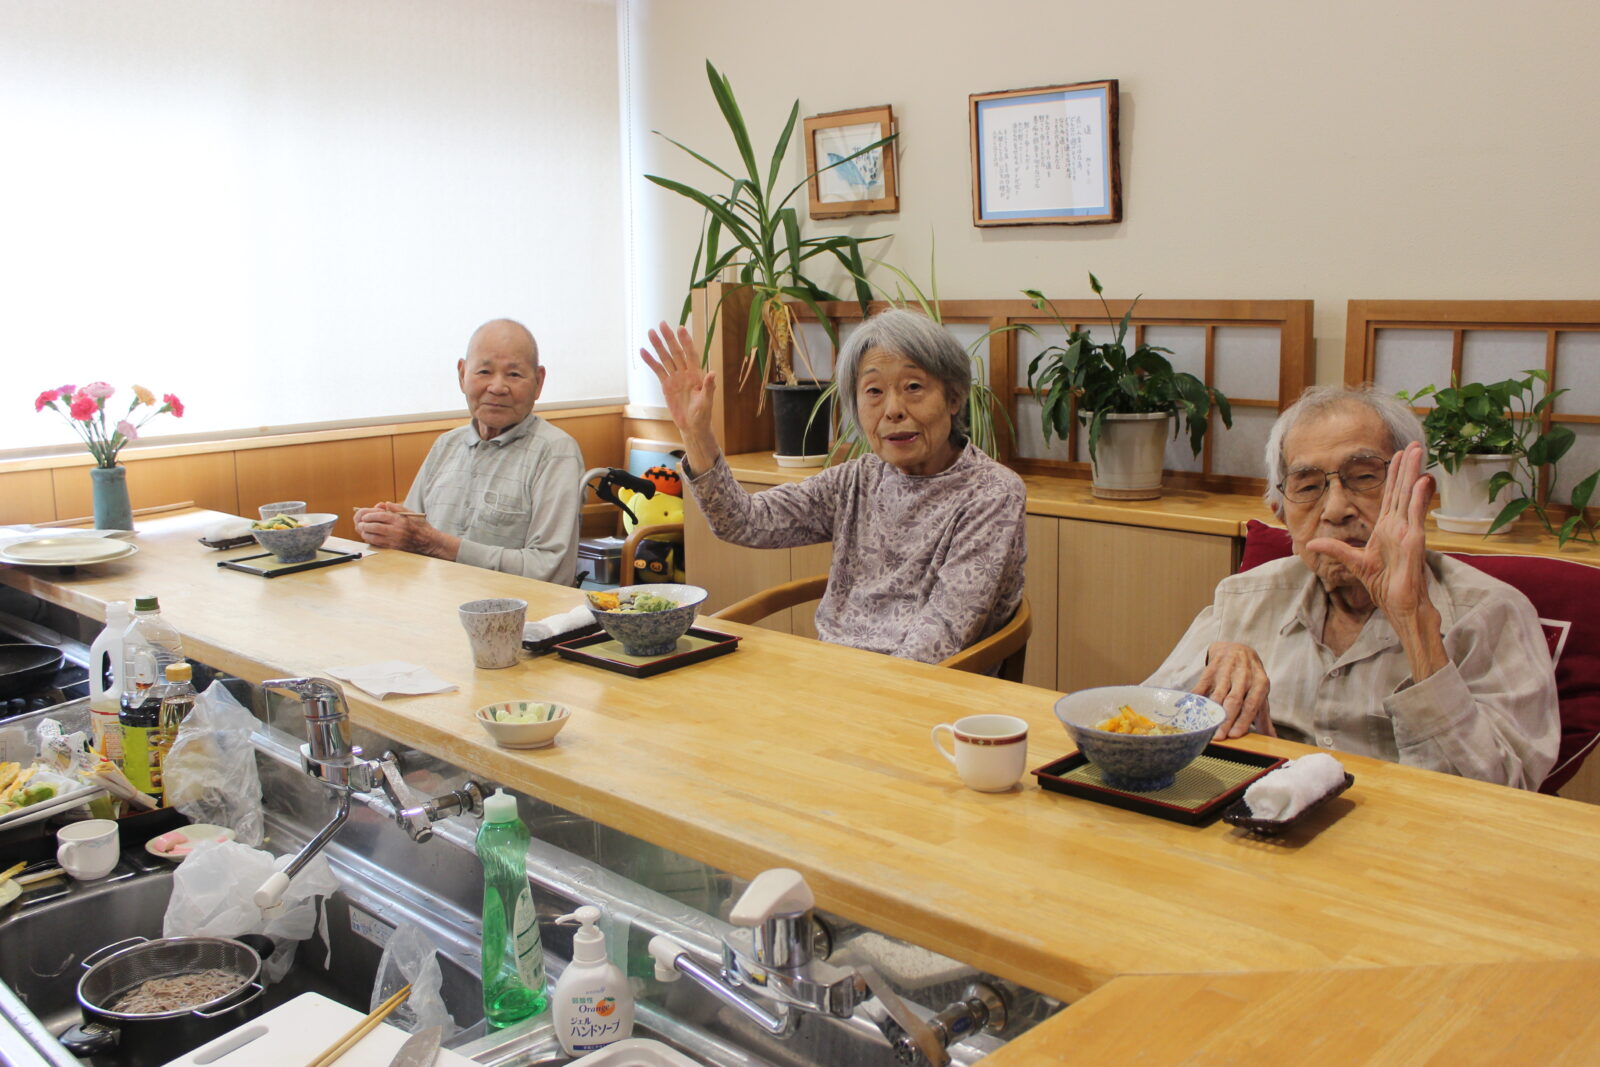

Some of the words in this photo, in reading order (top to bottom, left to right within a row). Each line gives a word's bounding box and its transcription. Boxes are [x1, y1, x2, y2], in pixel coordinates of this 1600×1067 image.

[579, 1005, 610, 1014] Orange
[570, 1017, 591, 1025] ジェル
[571, 1019, 620, 1037] ハンドソープ
